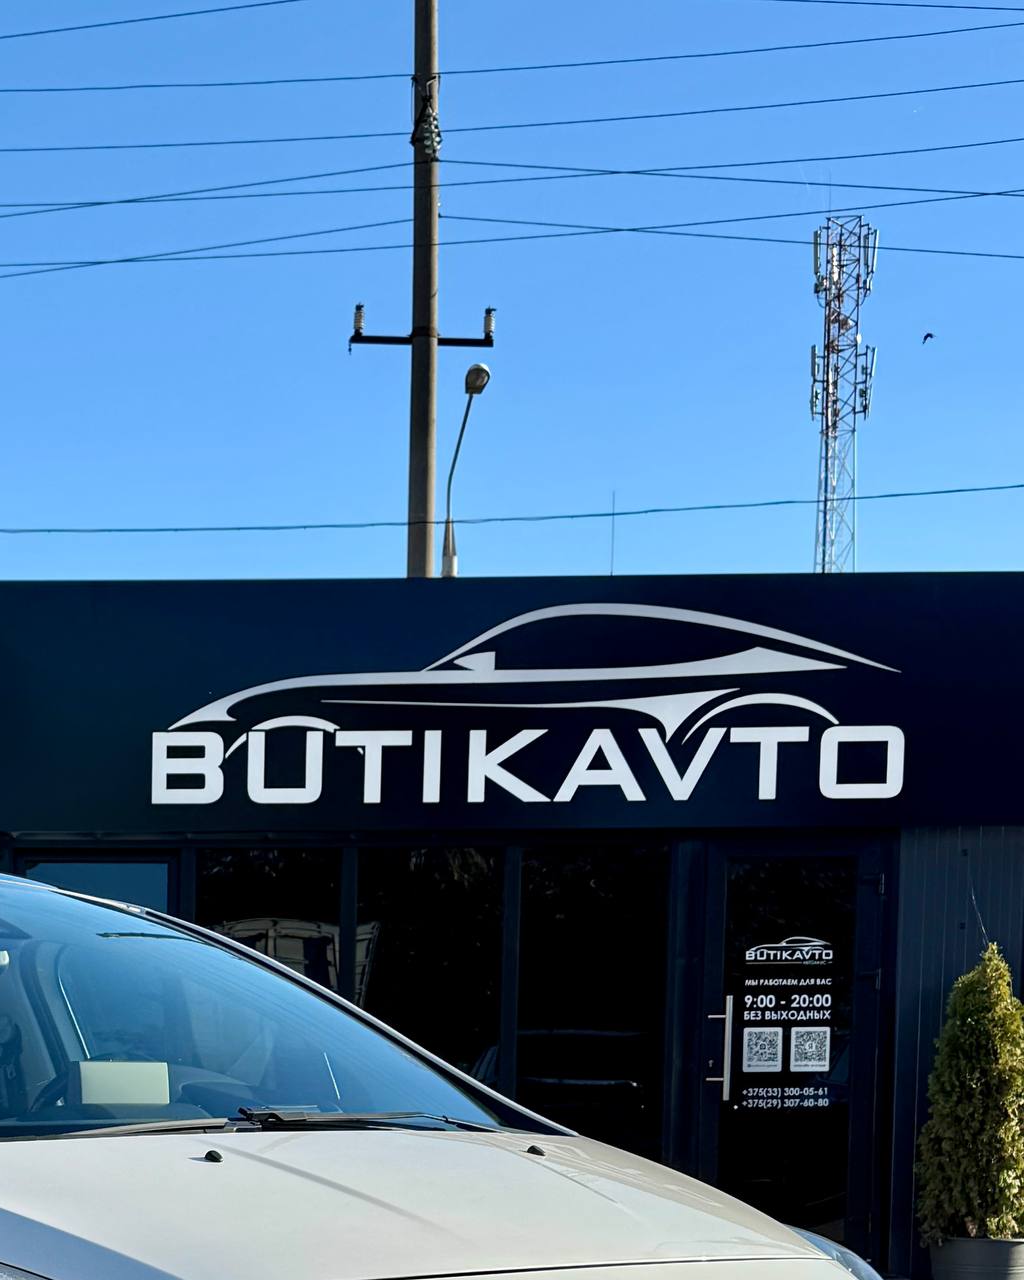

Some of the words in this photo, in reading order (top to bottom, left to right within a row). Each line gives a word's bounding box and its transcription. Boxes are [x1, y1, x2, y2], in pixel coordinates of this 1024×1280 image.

[151, 725, 905, 805] BUTIKAVTO
[745, 949, 834, 961] BUTIKAVTO
[759, 978, 798, 986] РАБОТАЕМ
[799, 978, 815, 986] ДЛЯ
[744, 994, 776, 1008] 9:00
[790, 994, 832, 1008] 20:00
[743, 1010, 762, 1020] БЕЗ
[764, 1009, 832, 1021] ВЫХОДНЫХ
[742, 1087, 782, 1098] +375(33)
[783, 1087, 828, 1096] 300-05-61
[742, 1098, 782, 1109] +375(29)
[783, 1098, 829, 1107] 307-60-80
